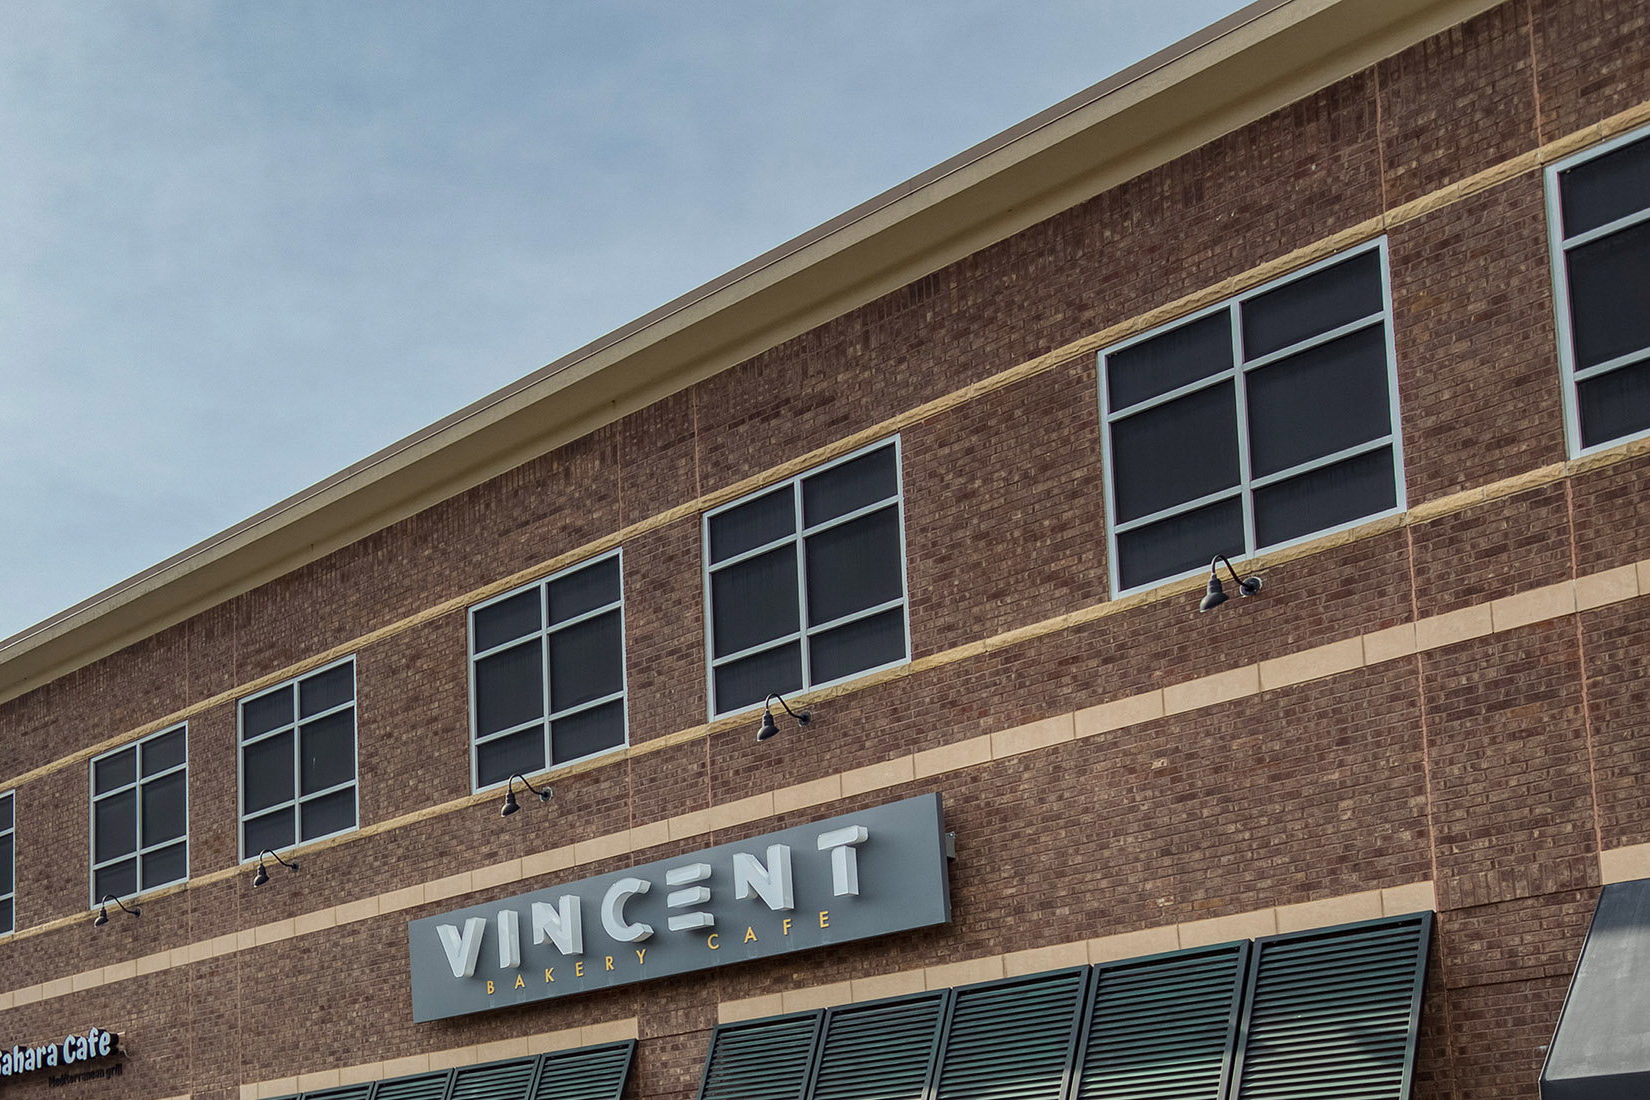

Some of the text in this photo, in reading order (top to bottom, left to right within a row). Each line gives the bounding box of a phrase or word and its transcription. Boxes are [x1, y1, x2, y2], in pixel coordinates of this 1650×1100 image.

[436, 825, 869, 979] VINCENT
[486, 910, 830, 995] BAKERY CAFE
[63, 1026, 112, 1064] Cafe
